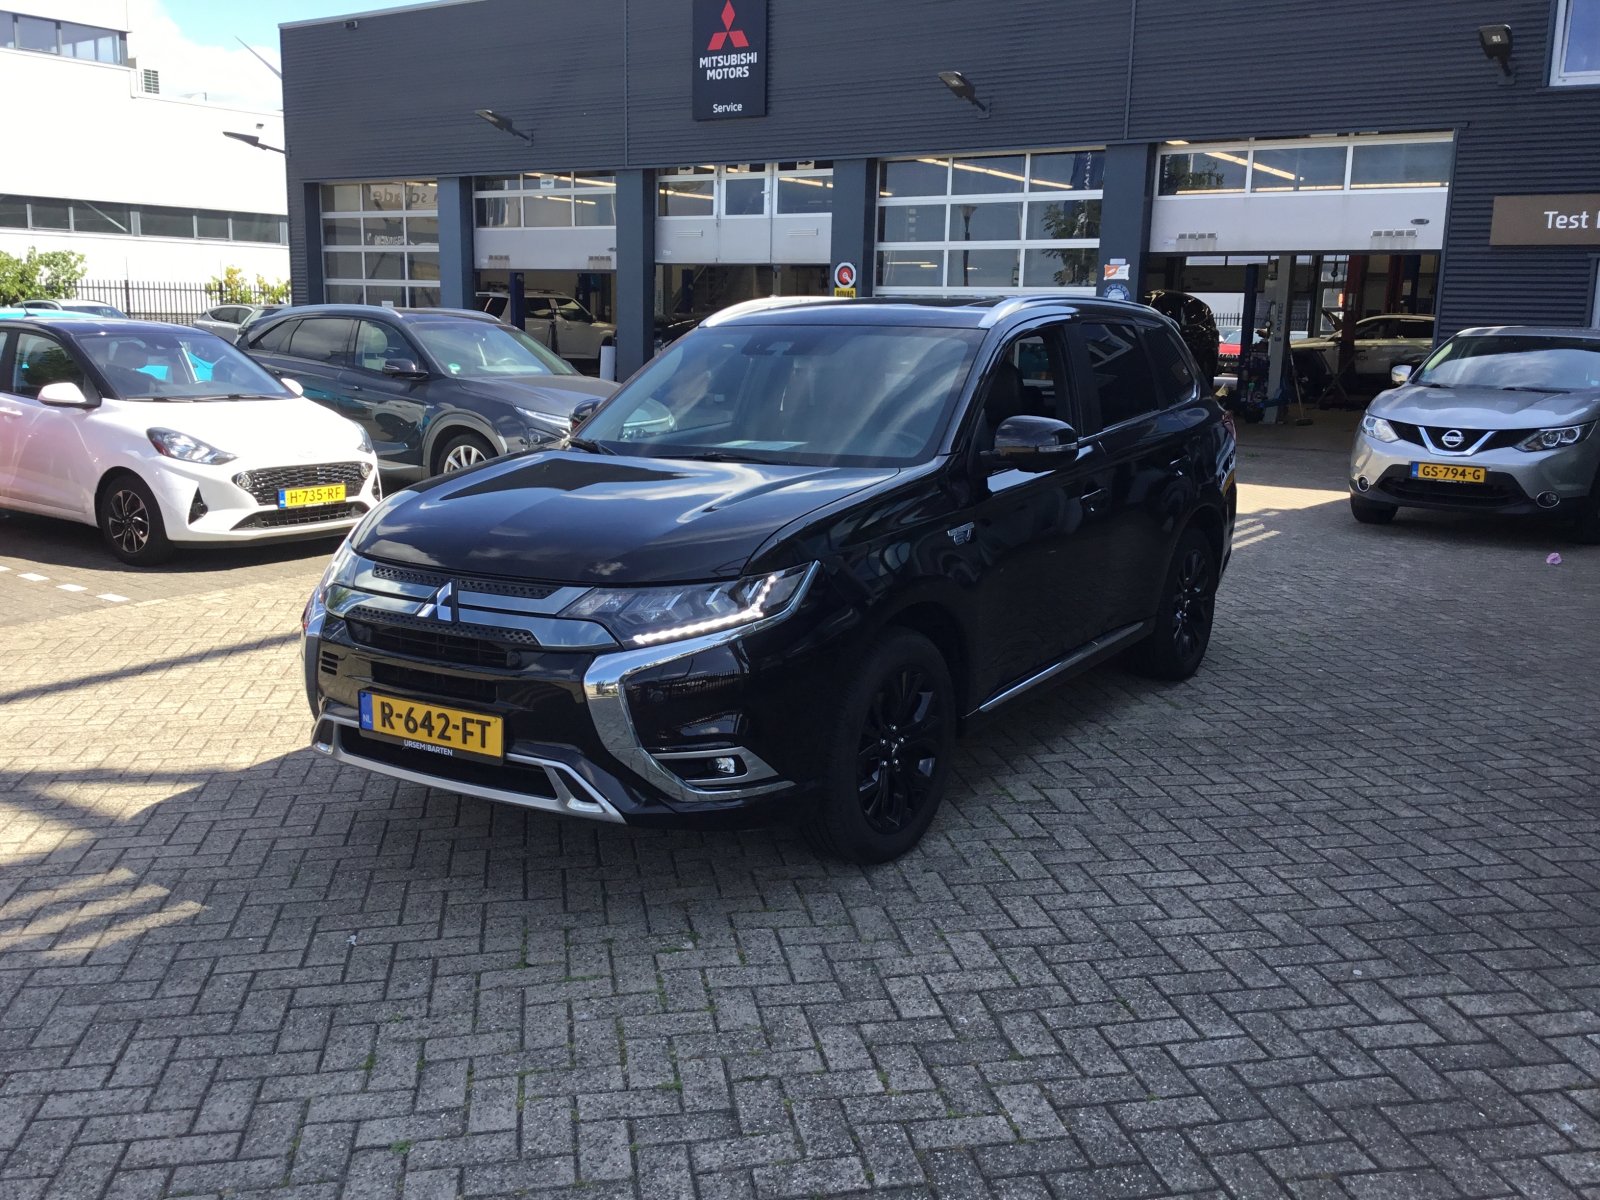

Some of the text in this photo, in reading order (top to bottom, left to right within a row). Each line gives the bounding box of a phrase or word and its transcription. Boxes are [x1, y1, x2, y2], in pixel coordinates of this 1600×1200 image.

[700, 52, 758, 68] MITSUBISHI
[706, 66, 749, 80] MOTORS
[713, 102, 743, 113] Service
[1543, 210, 1589, 229] Test
[1422, 465, 1480, 480] GS-794-G
[290, 486, 341, 504] H-735-RF
[362, 713, 372, 724] NL
[380, 701, 491, 749] R-642-FT
